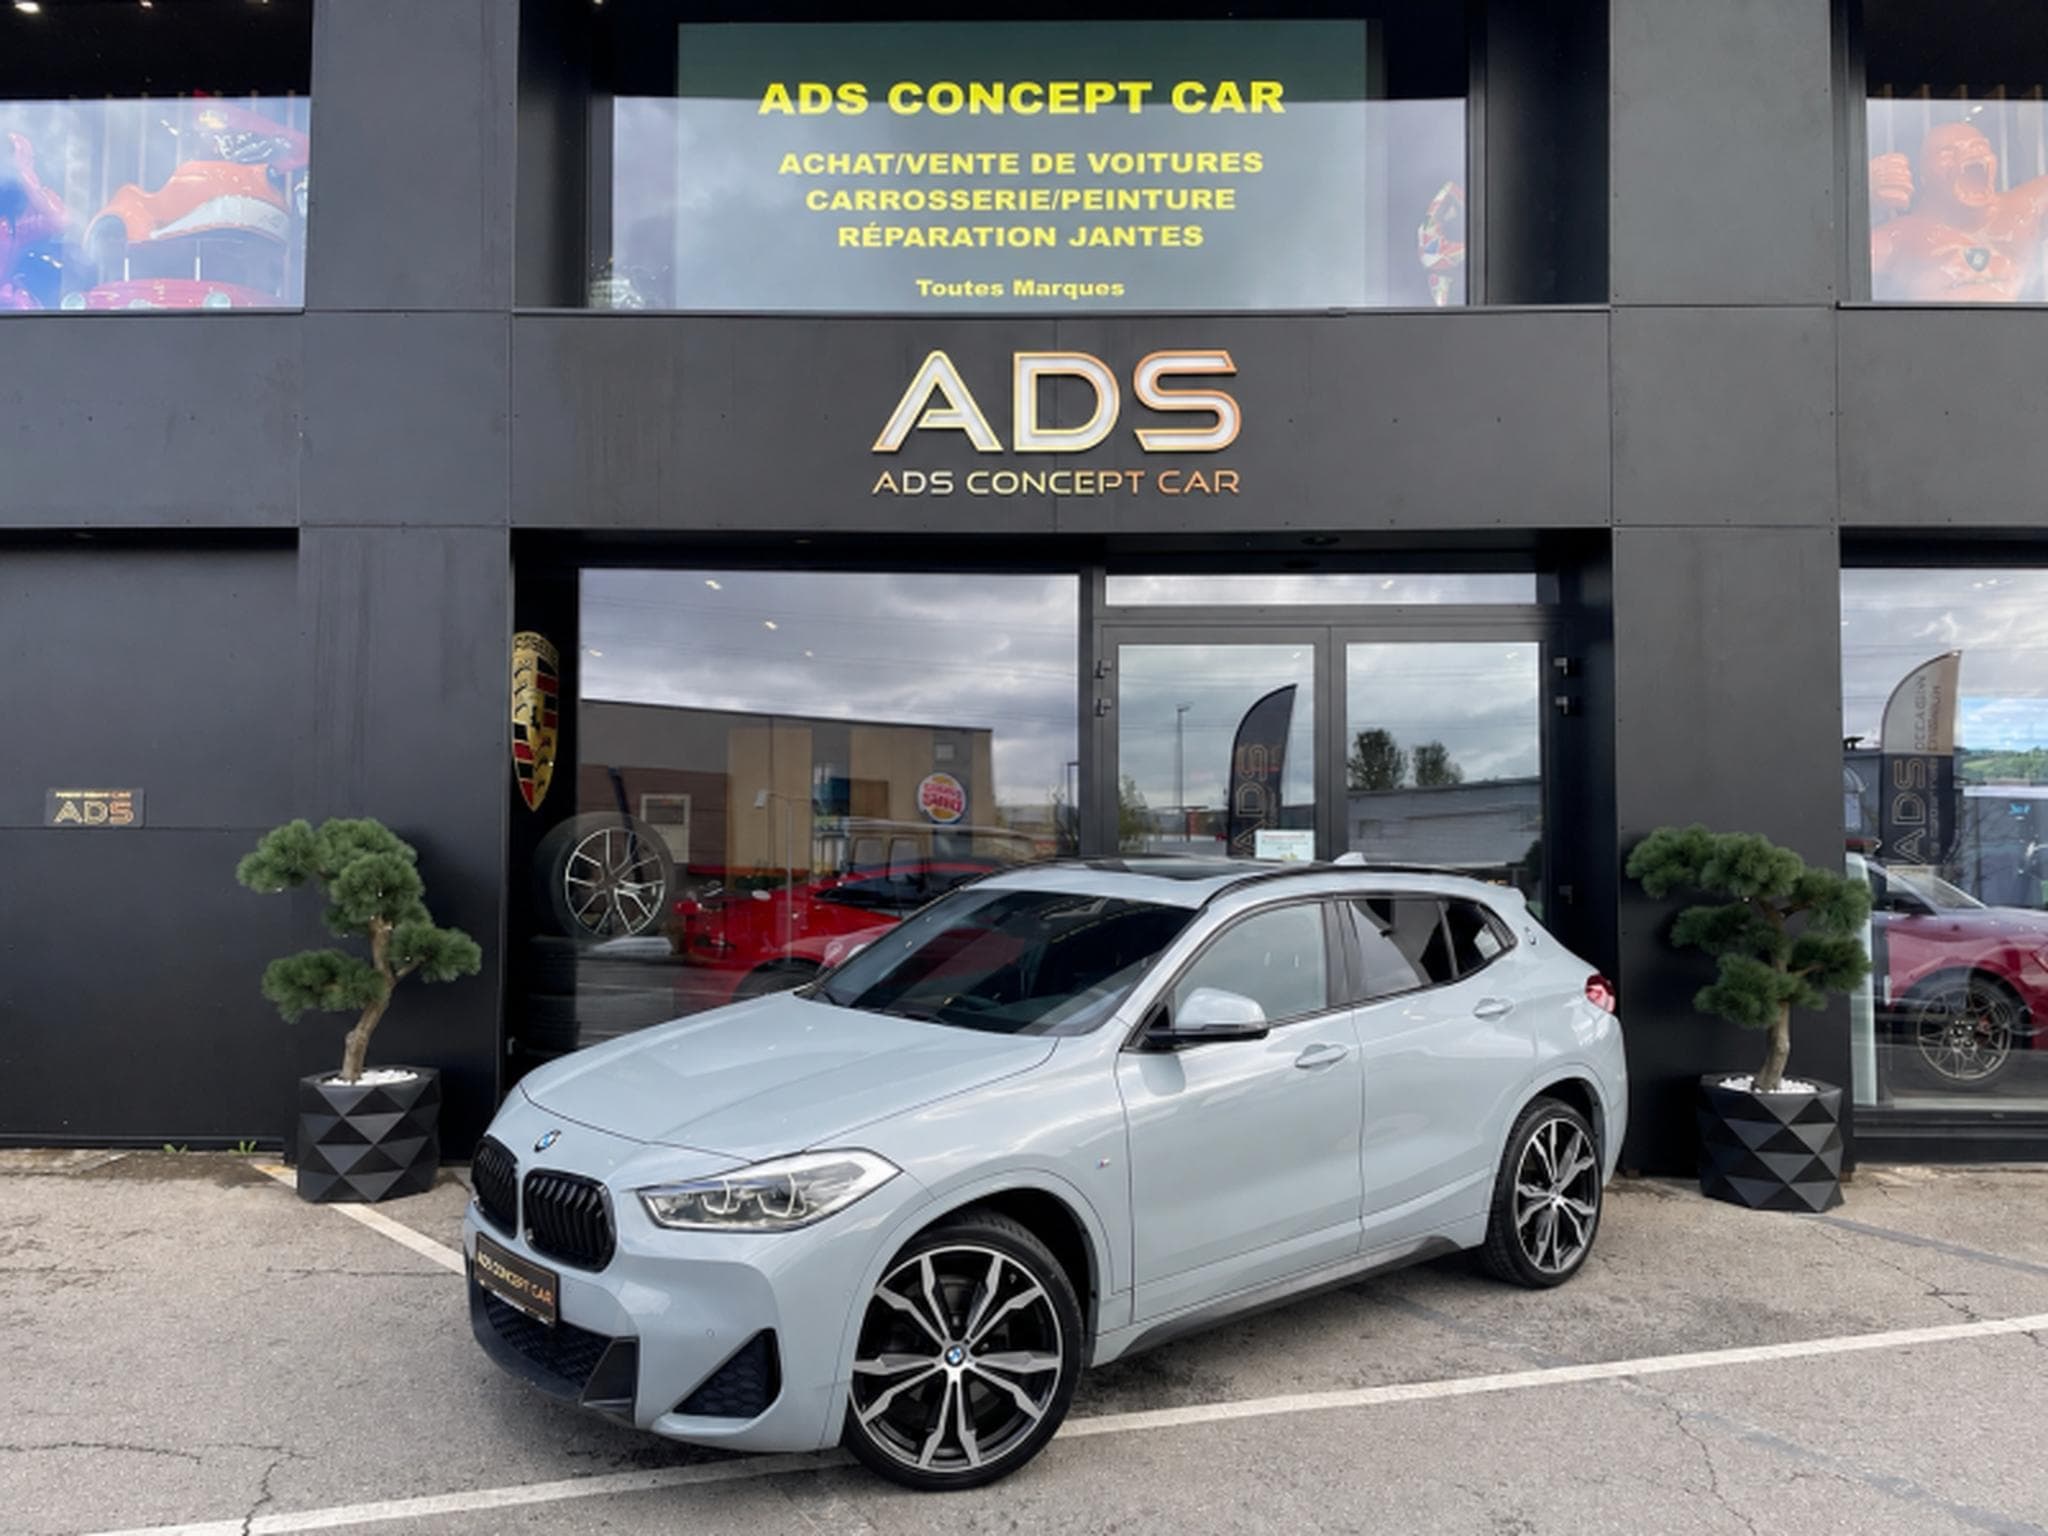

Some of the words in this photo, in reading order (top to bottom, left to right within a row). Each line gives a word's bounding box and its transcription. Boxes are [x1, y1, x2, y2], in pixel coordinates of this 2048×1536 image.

[759, 81, 869, 115] ADS
[886, 80, 1153, 116] CONCEPT
[1170, 79, 1285, 114] CAR
[779, 152, 1019, 175] ACHAT/VENTE
[1031, 152, 1076, 175] DE
[1087, 151, 1264, 174] VOITURES
[806, 188, 1236, 211] CARROSSERIE/PEINTURE
[838, 222, 1057, 248] RÉPARATION
[1069, 225, 1204, 247] JANTES
[916, 279, 1004, 297] Toutes
[1013, 279, 1125, 300] Marques
[872, 349, 1242, 453] ADS
[872, 470, 954, 495] ADS
[966, 470, 1145, 495] CONCEPT
[1157, 469, 1240, 494] CAR
[53, 800, 134, 825] ADS
[1893, 758, 1926, 863] ADS
